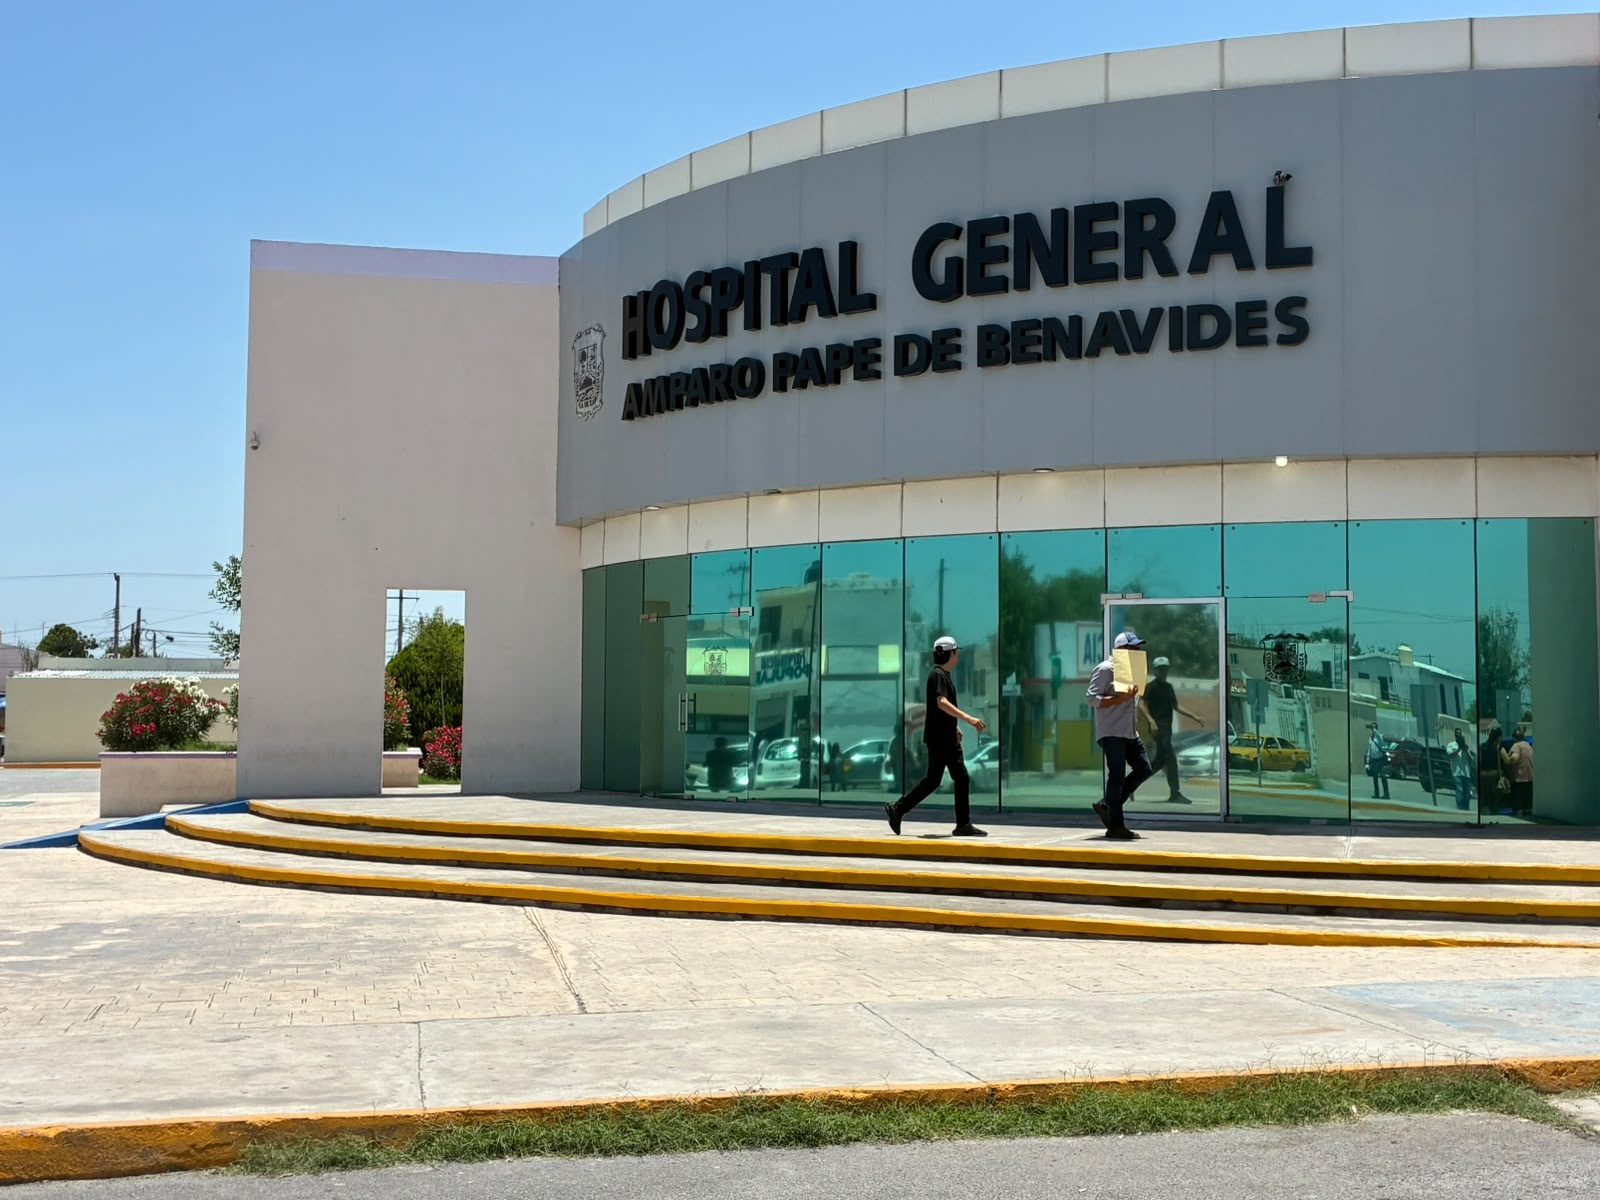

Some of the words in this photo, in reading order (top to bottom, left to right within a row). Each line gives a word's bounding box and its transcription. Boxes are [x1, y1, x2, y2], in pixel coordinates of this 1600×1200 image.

[622, 240, 877, 360] HOSPITAL
[911, 186, 1313, 302] GENERAL
[621, 357, 766, 421] AMPARO
[772, 338, 882, 393] PAPE
[893, 327, 962, 377] DE
[976, 296, 1309, 368] BENAVIDES
